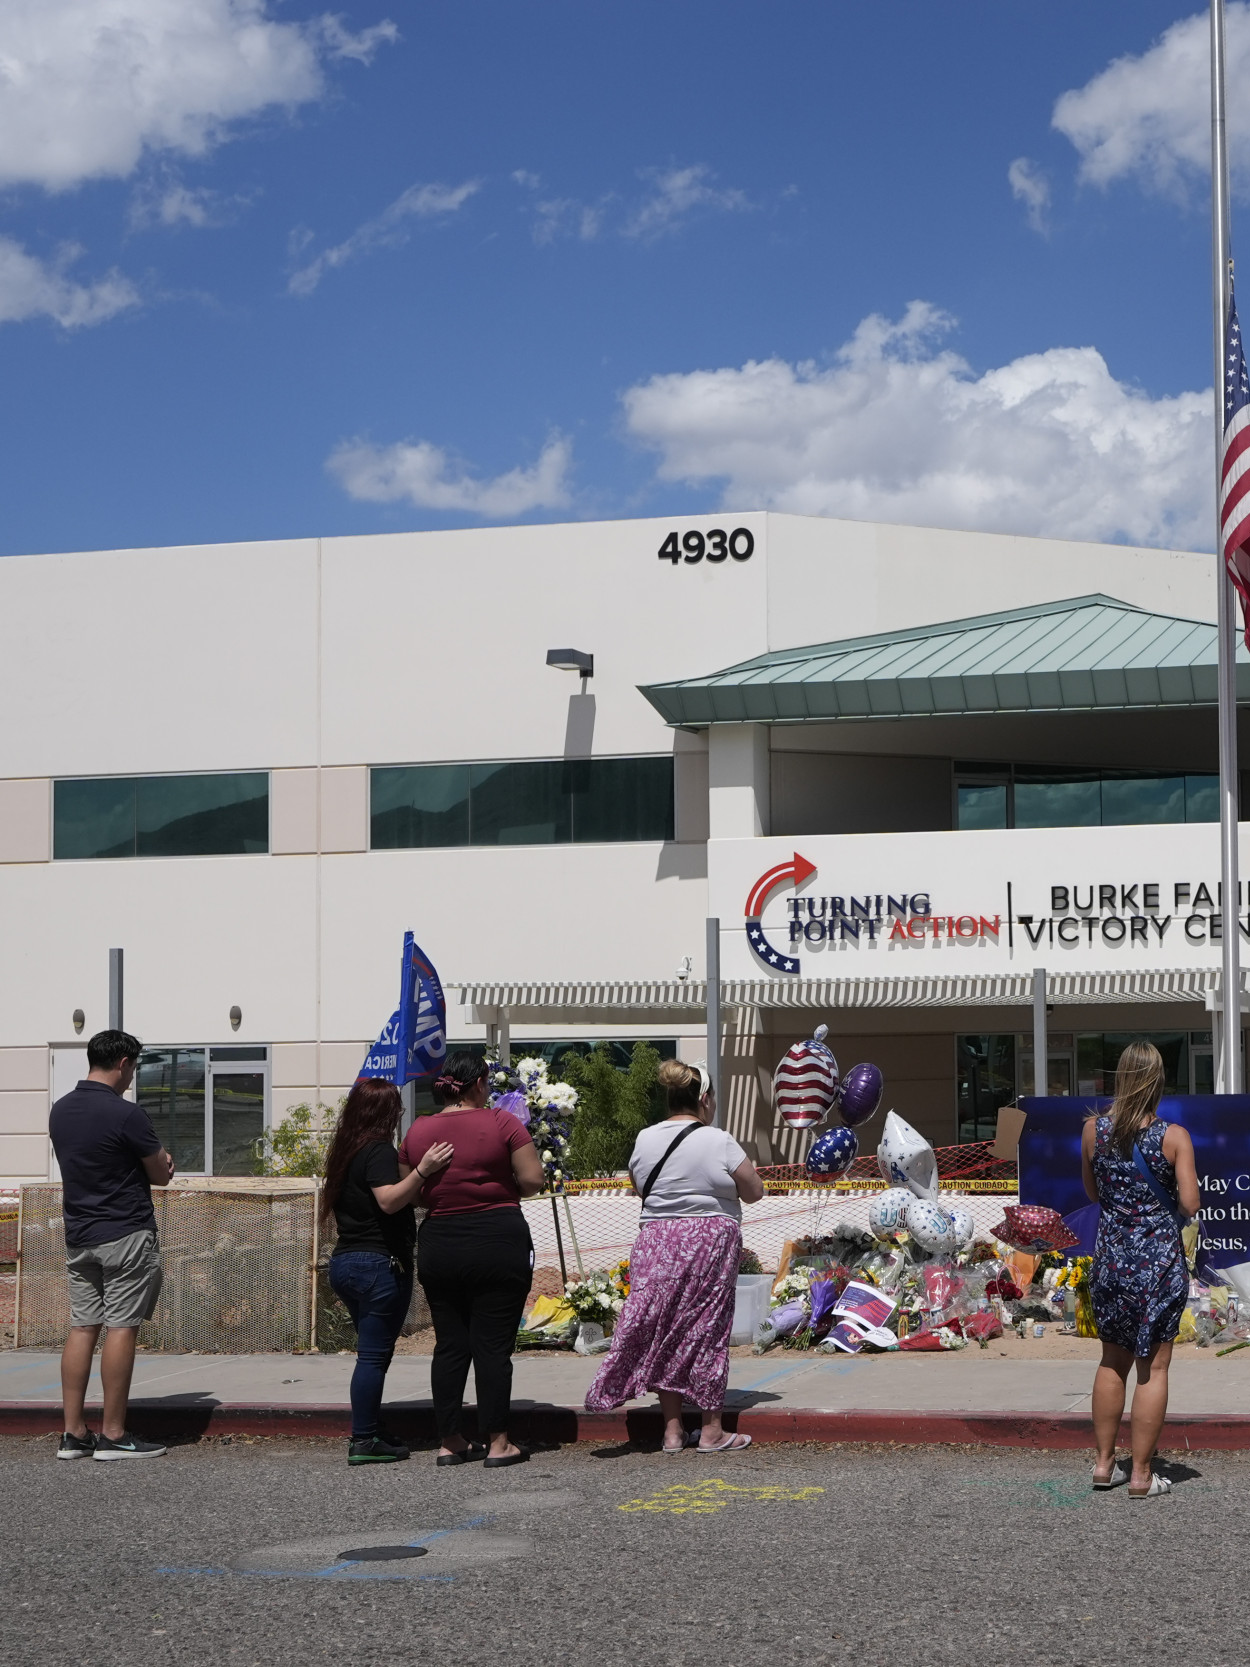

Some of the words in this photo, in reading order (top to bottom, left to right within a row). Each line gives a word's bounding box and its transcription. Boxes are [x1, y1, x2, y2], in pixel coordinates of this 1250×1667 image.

[658, 527, 755, 565] 4930
[787, 893, 931, 919] TURNING
[1051, 883, 1160, 911] BURKE
[788, 918, 881, 942] POINT
[887, 914, 1001, 940] ACTION
[1023, 915, 1172, 943] VICTORY
[564, 1182, 587, 1190] UTION
[591, 1181, 624, 1189] CUIDADO
[767, 1181, 801, 1189] CAUTION
[851, 1181, 886, 1189] CAUTION
[938, 1181, 971, 1189] CAUTION
[974, 1181, 1009, 1189] CUIDADO
[1197, 1174, 1232, 1195] May
[1195, 1206, 1226, 1221] nto
[1197, 1234, 1248, 1252] Jesus,
